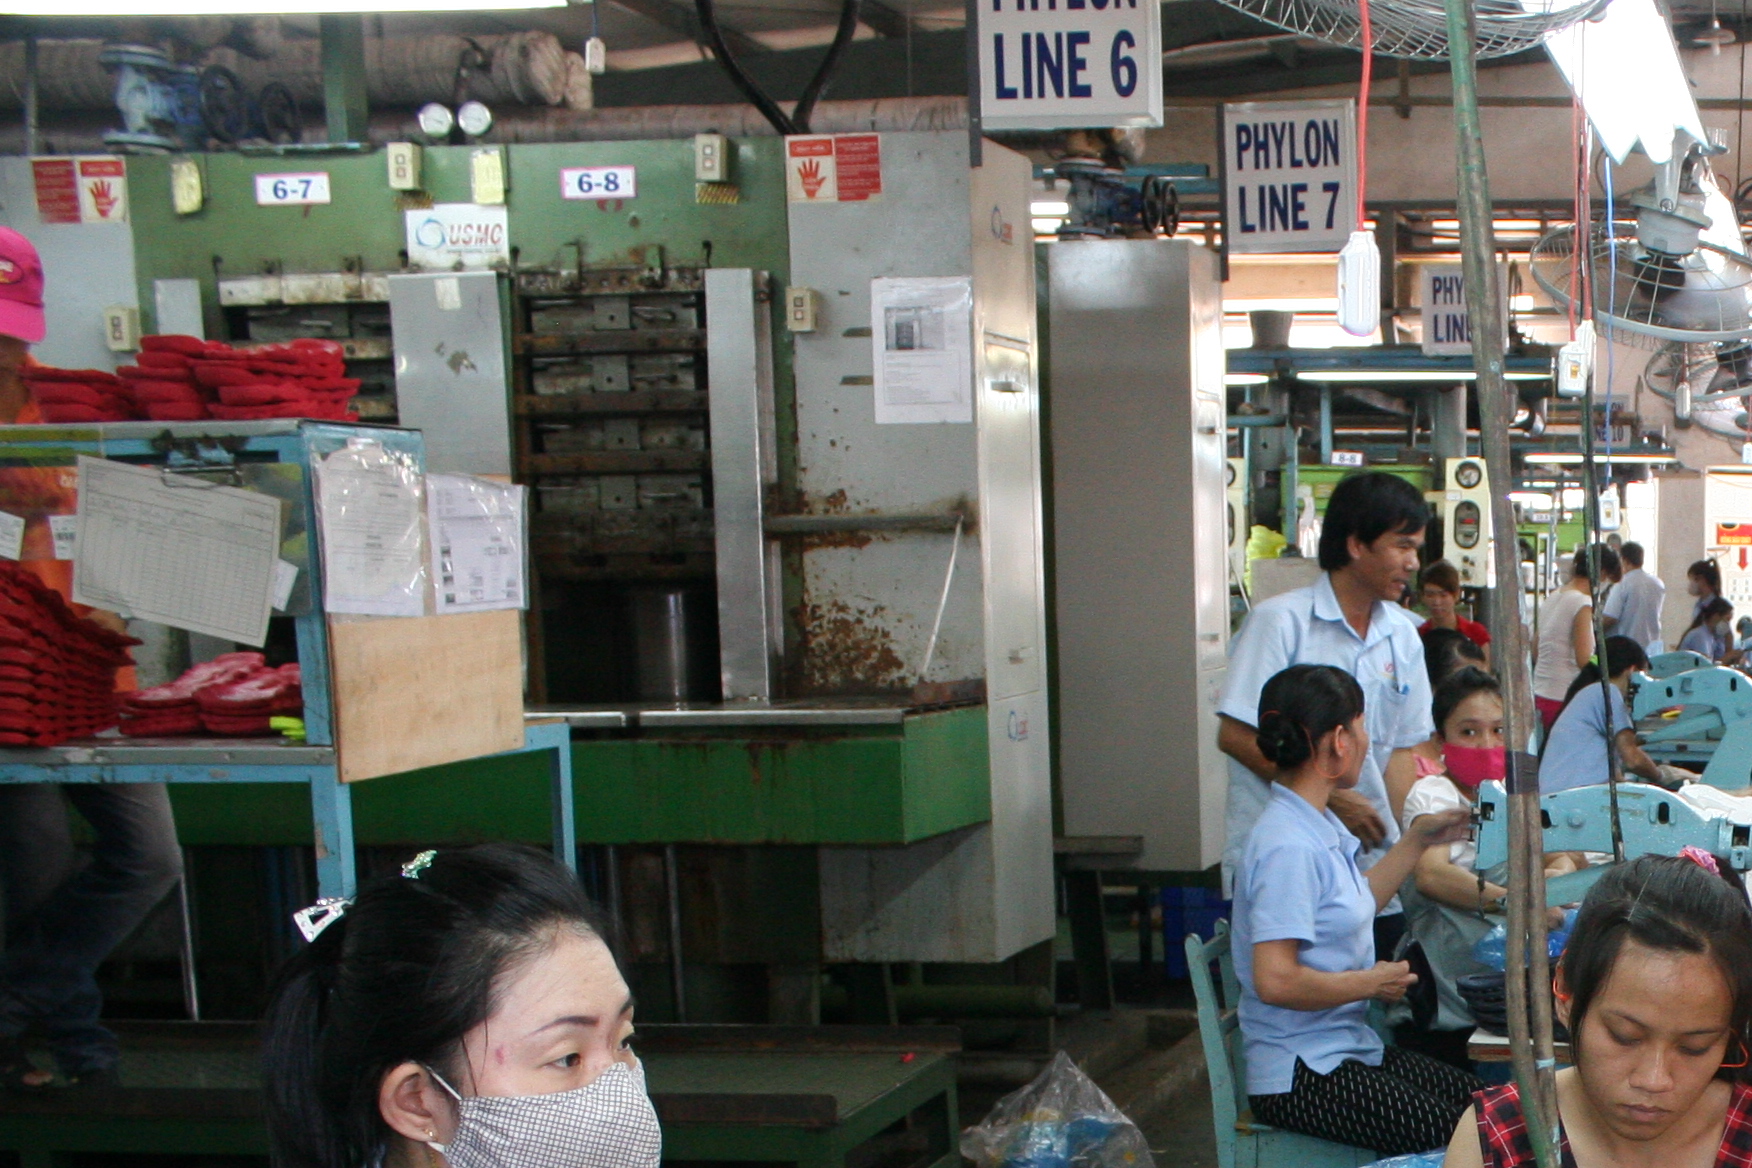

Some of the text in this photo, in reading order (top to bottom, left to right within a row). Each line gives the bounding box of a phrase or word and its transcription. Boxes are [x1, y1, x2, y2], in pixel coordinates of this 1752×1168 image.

[994, 29, 1138, 100] LINE 6
[1235, 118, 1340, 171] PHYLON
[272, 179, 313, 200] 6-7
[577, 173, 621, 194] 6-8
[1238, 181, 1340, 233] LINE 7
[448, 223, 502, 247] USMC
[1432, 276, 1465, 305] PHY
